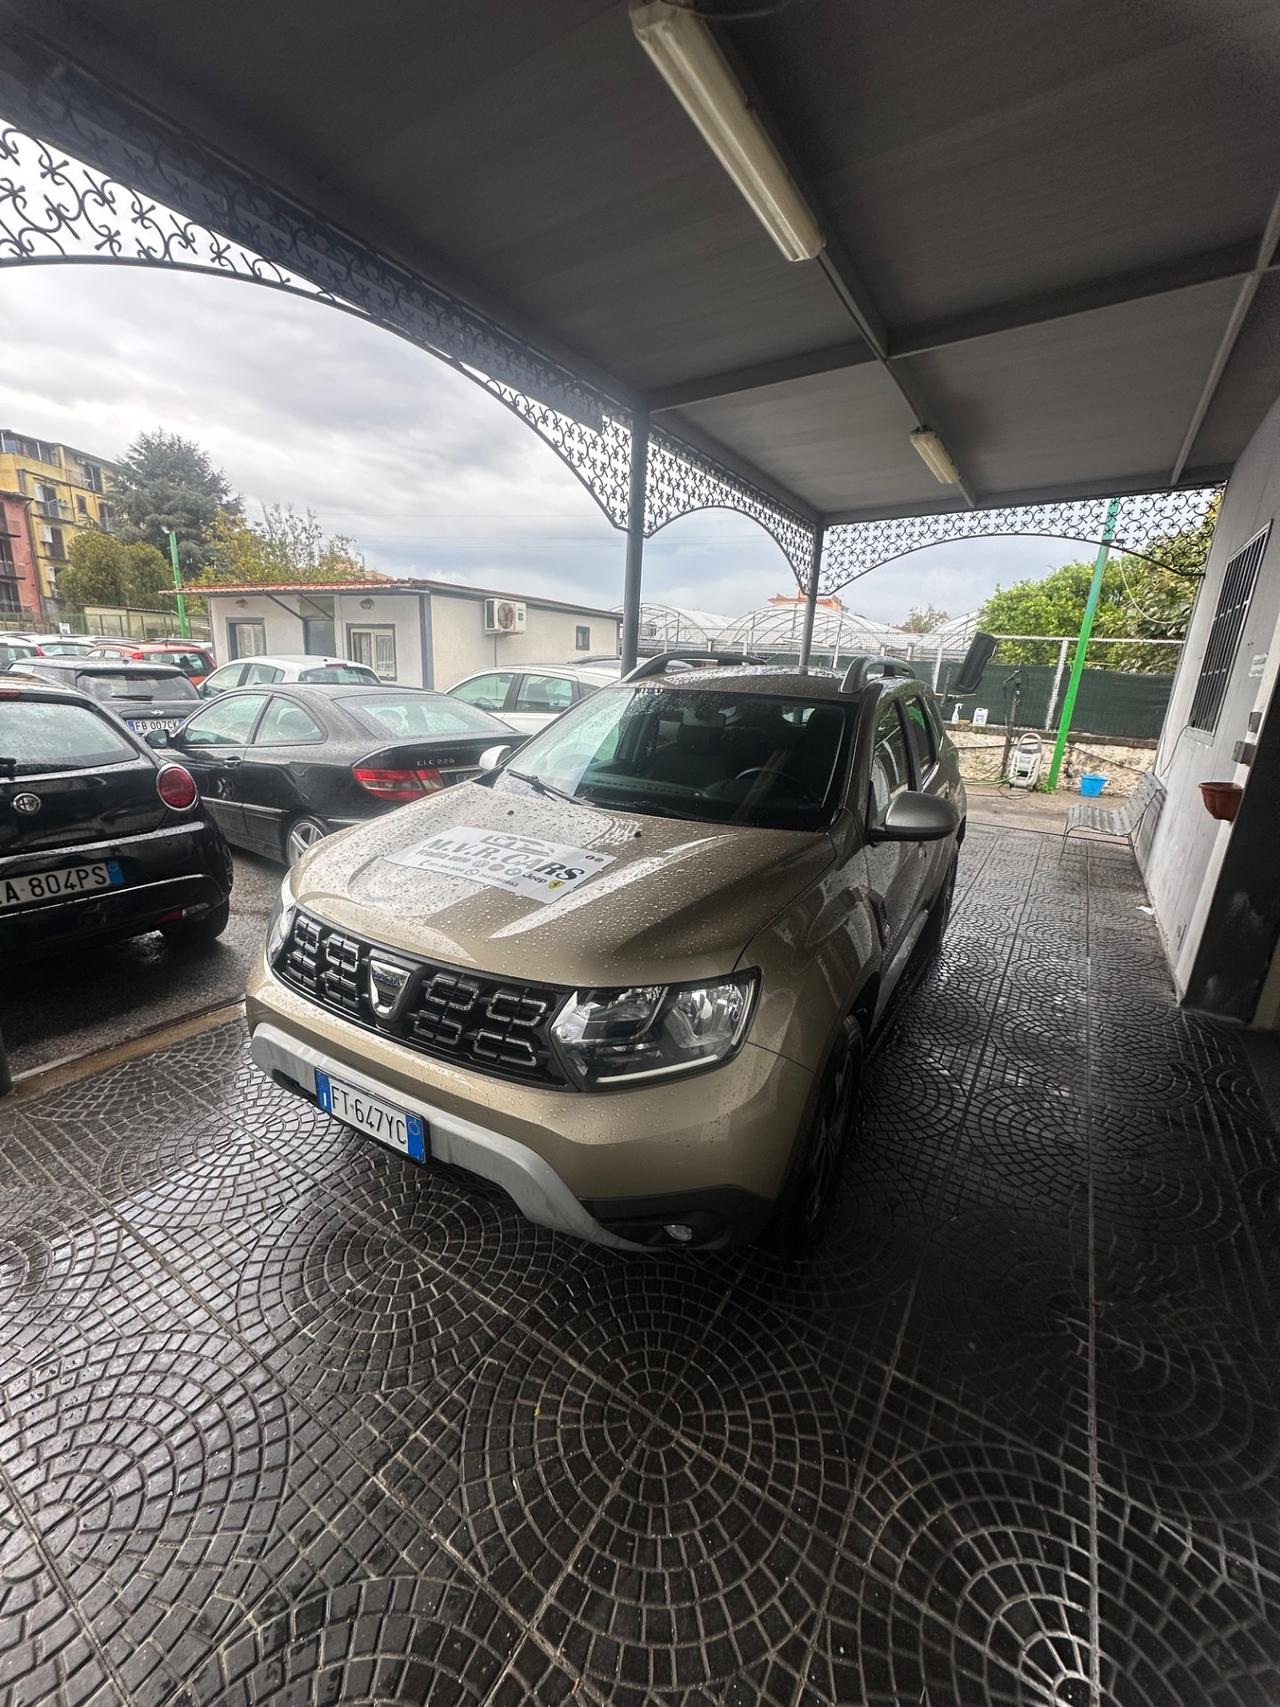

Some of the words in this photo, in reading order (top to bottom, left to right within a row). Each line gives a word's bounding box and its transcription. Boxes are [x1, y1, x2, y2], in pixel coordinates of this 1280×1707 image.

[422, 838, 501, 861] M.V.R.
[501, 853, 585, 881] CARS
[522, 873, 548, 884] Jeep
[0, 881, 20, 905] A
[28, 866, 107, 898] 804PS
[331, 1085, 350, 1115] FT
[354, 1098, 406, 1145] 647YC
